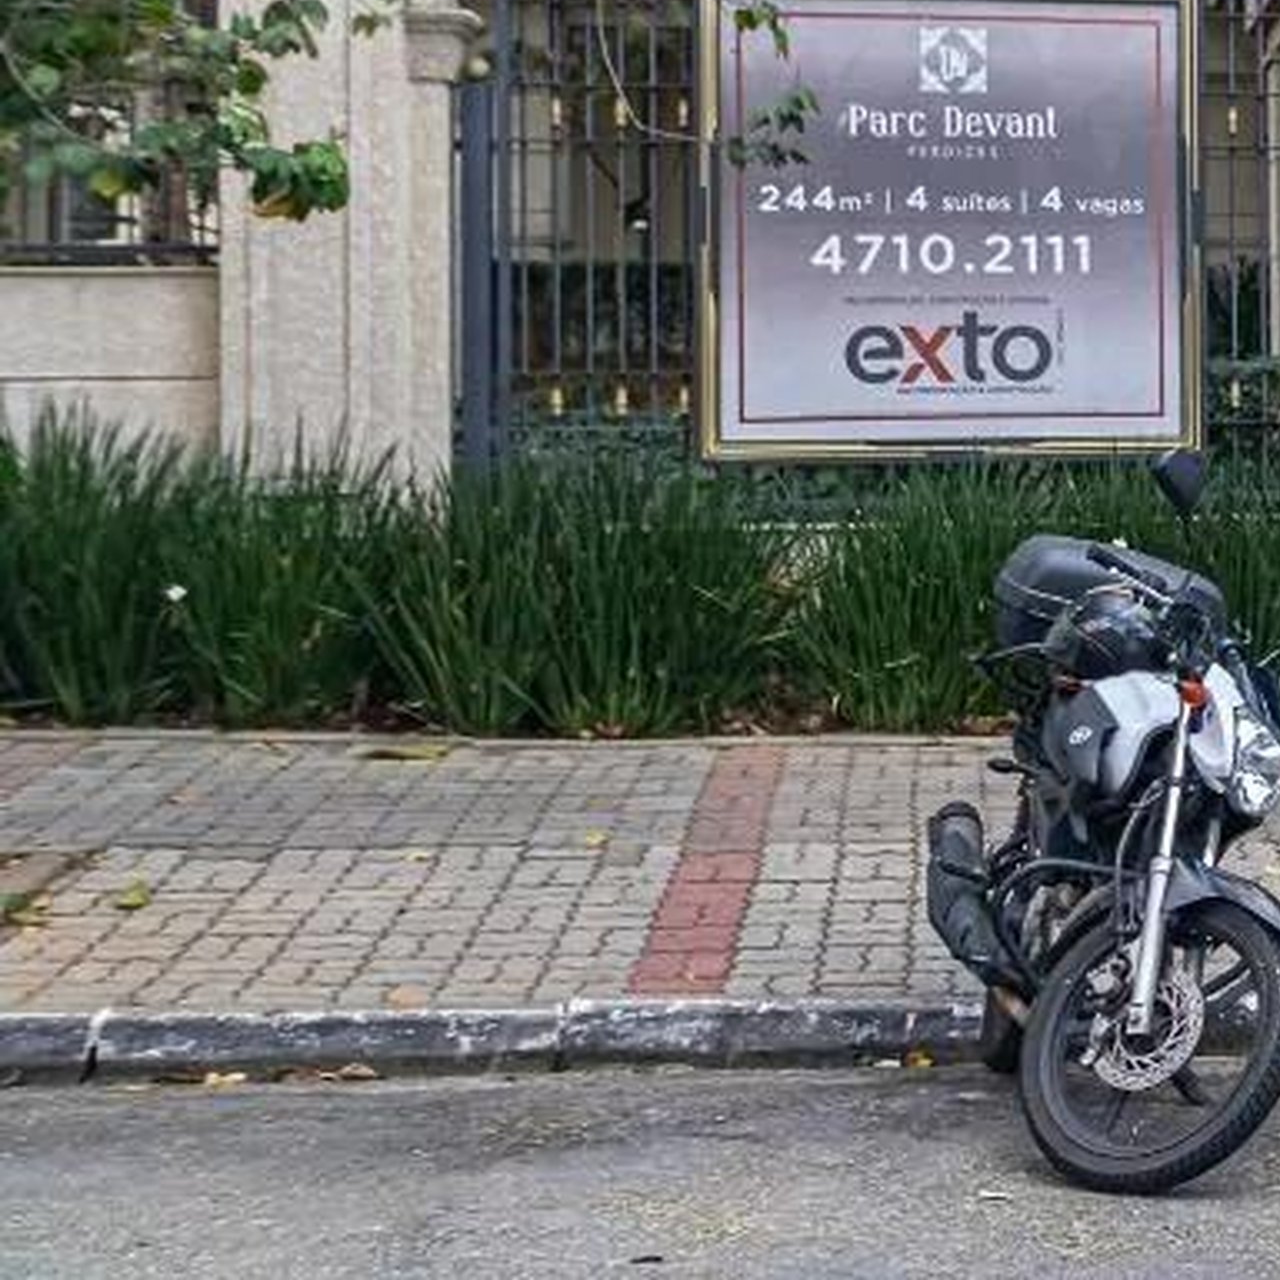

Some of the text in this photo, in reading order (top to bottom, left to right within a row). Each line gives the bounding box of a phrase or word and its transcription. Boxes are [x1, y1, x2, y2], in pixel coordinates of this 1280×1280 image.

[848, 104, 1058, 139] Parc Devant
[906, 185, 928, 212] 4
[1040, 185, 1064, 212] 4
[1075, 198, 1145, 218] vagas
[810, 233, 1091, 274] 4710.2111
[845, 311, 1053, 384] exto
